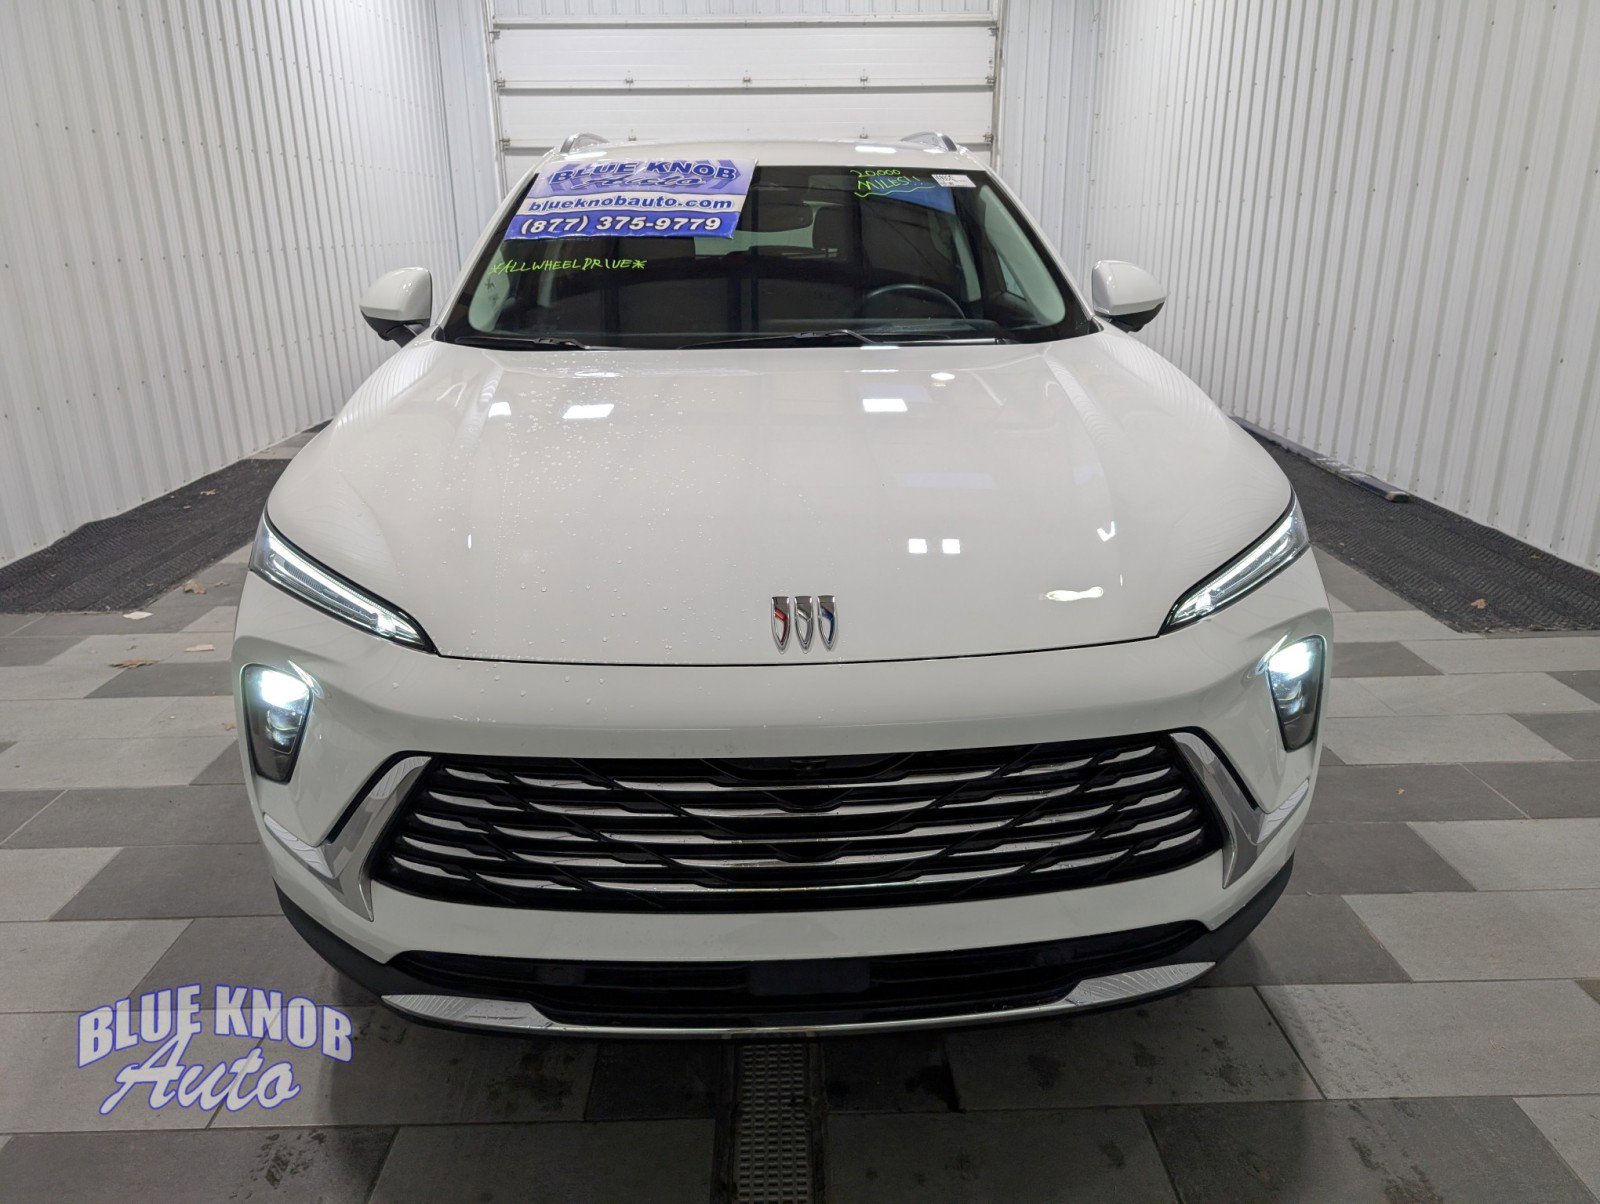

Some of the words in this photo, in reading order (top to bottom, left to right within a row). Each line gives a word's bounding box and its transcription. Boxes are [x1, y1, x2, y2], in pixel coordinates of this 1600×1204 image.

[550, 161, 638, 185] BLUE
[646, 160, 738, 181] KNOB
[570, 174, 707, 190] Auto
[528, 194, 733, 213] blueknobauto.com
[520, 216, 589, 235] (877)
[596, 216, 722, 232] 375-9779
